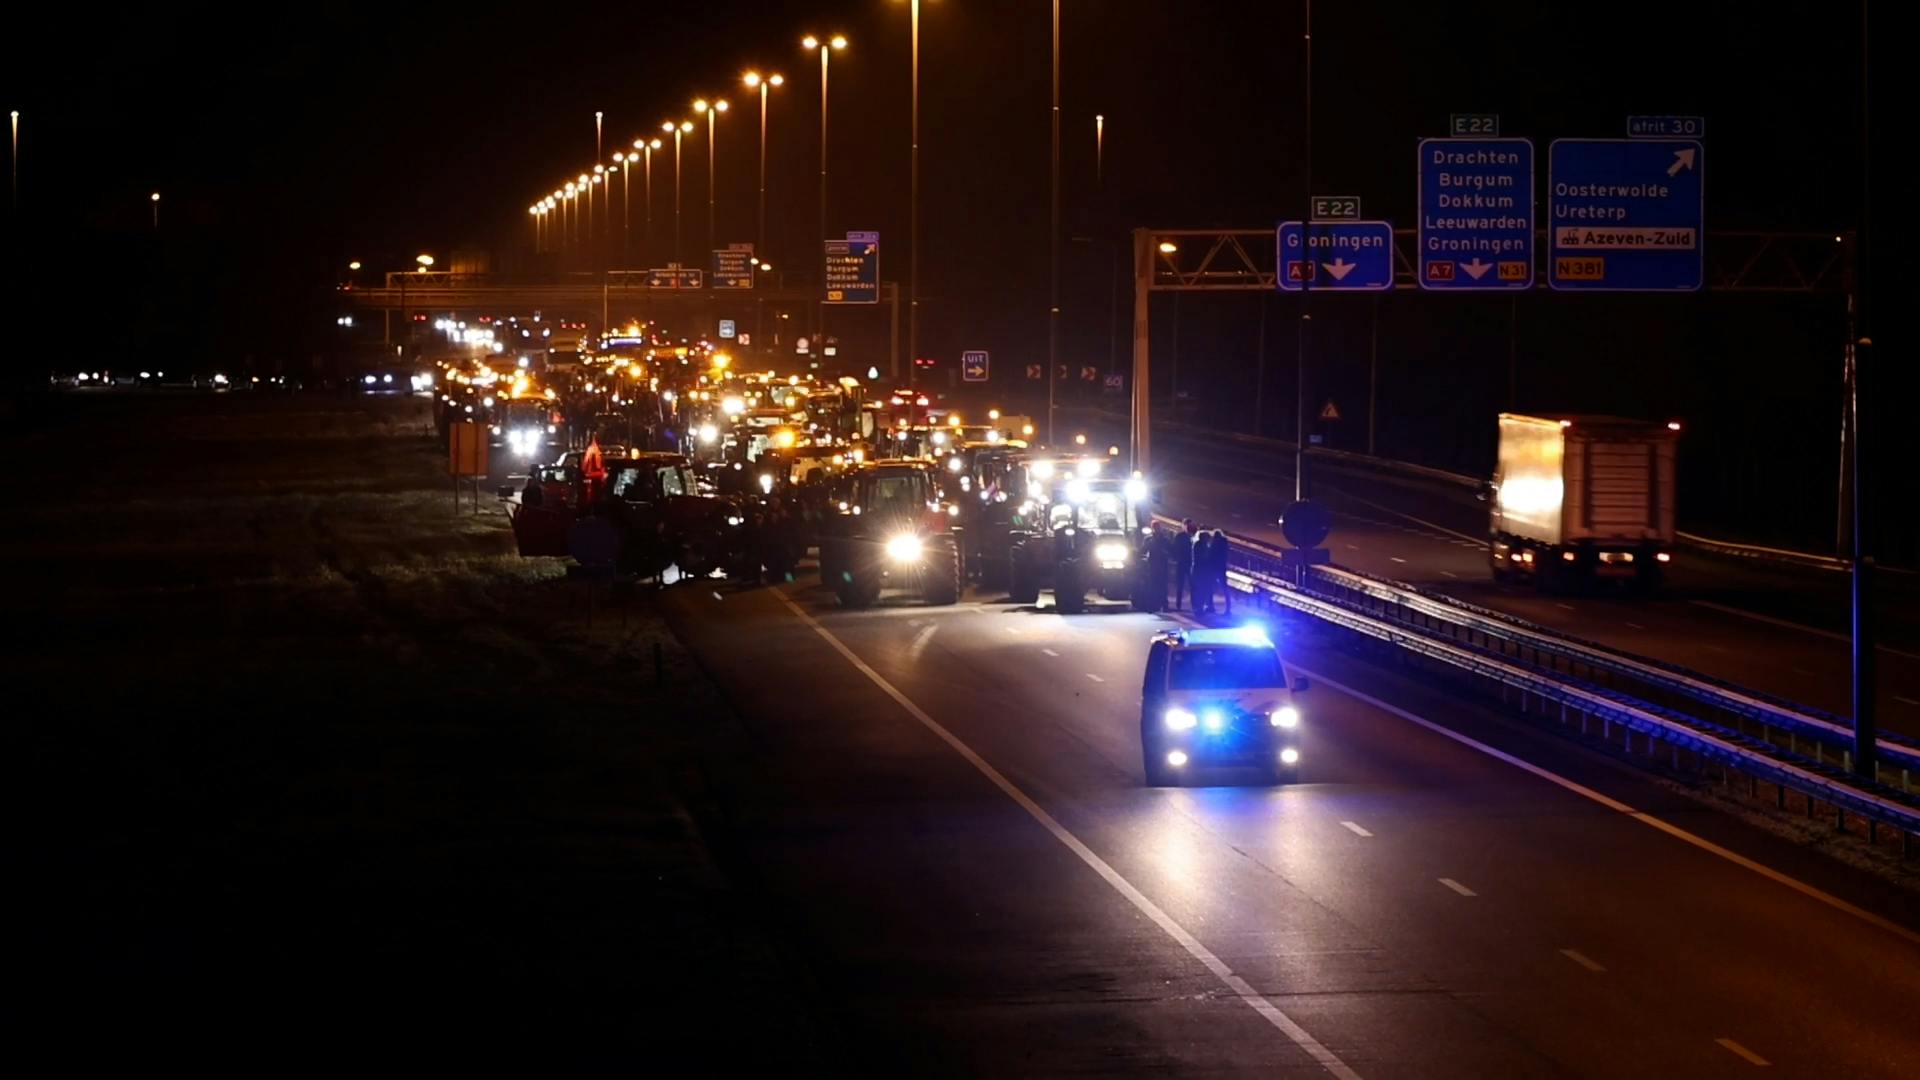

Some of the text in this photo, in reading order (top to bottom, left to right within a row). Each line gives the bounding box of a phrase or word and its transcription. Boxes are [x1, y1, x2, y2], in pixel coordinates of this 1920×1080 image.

[1632, 120, 1696, 134] afrit 30
[1433, 150, 1519, 164] Drachten
[1439, 173, 1513, 190] Burgum
[1556, 183, 1669, 197] Oosterwolde
[1439, 194, 1513, 208] Dokkum
[1555, 204, 1626, 220] Ureterp
[1425, 215, 1527, 229] Leeuwarden
[1287, 233, 1383, 251] Goningen
[1584, 231, 1691, 245] Azeven-Zuid
[1428, 237, 1524, 254] Groningen
